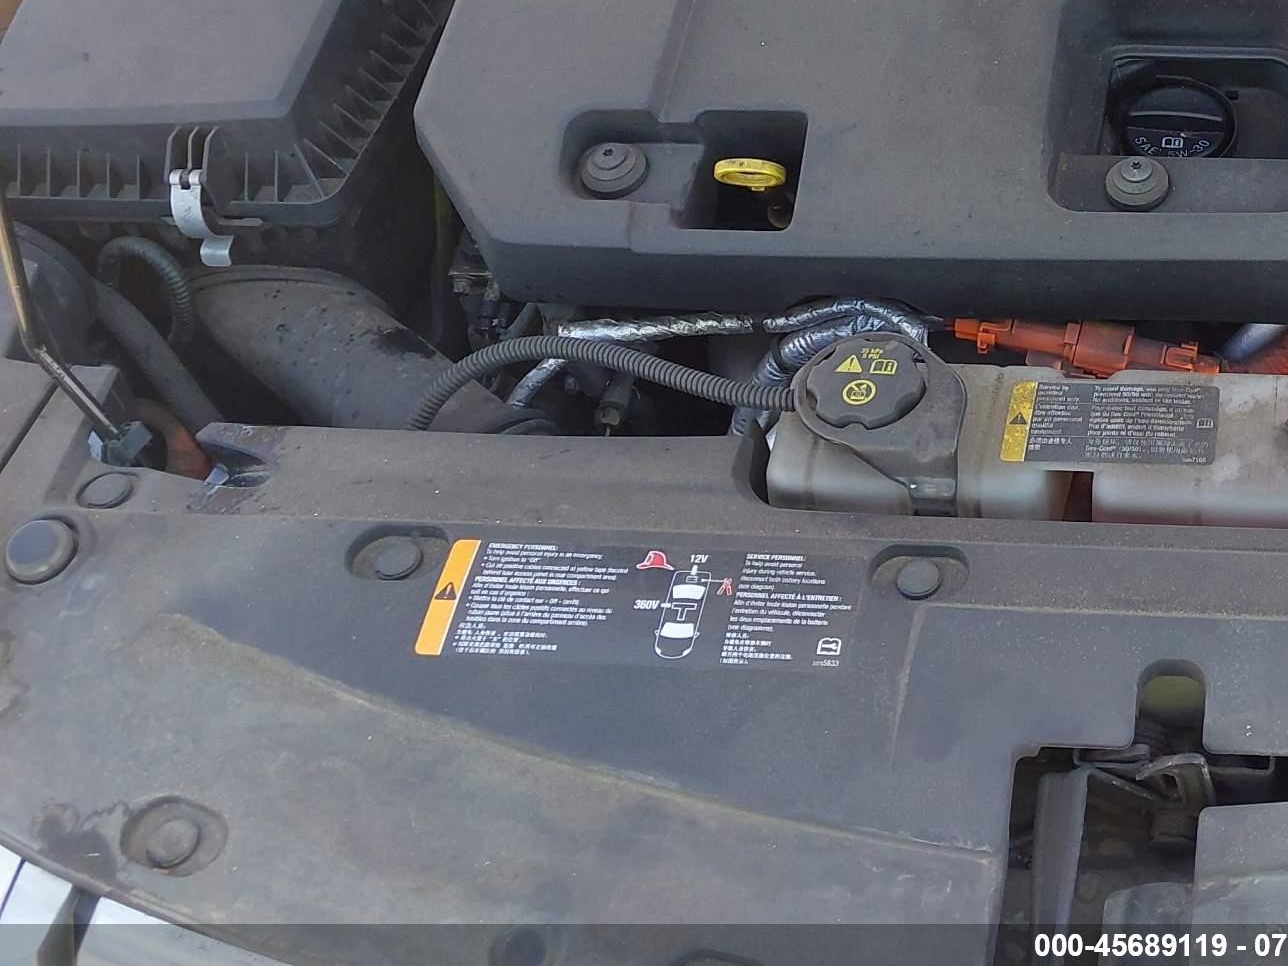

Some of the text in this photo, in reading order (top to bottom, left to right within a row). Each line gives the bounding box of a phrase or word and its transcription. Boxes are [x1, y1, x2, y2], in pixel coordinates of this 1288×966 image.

[1135, 136, 1159, 155] SAE
[690, 554, 709, 563] 12V
[634, 599, 660, 610] 360V
